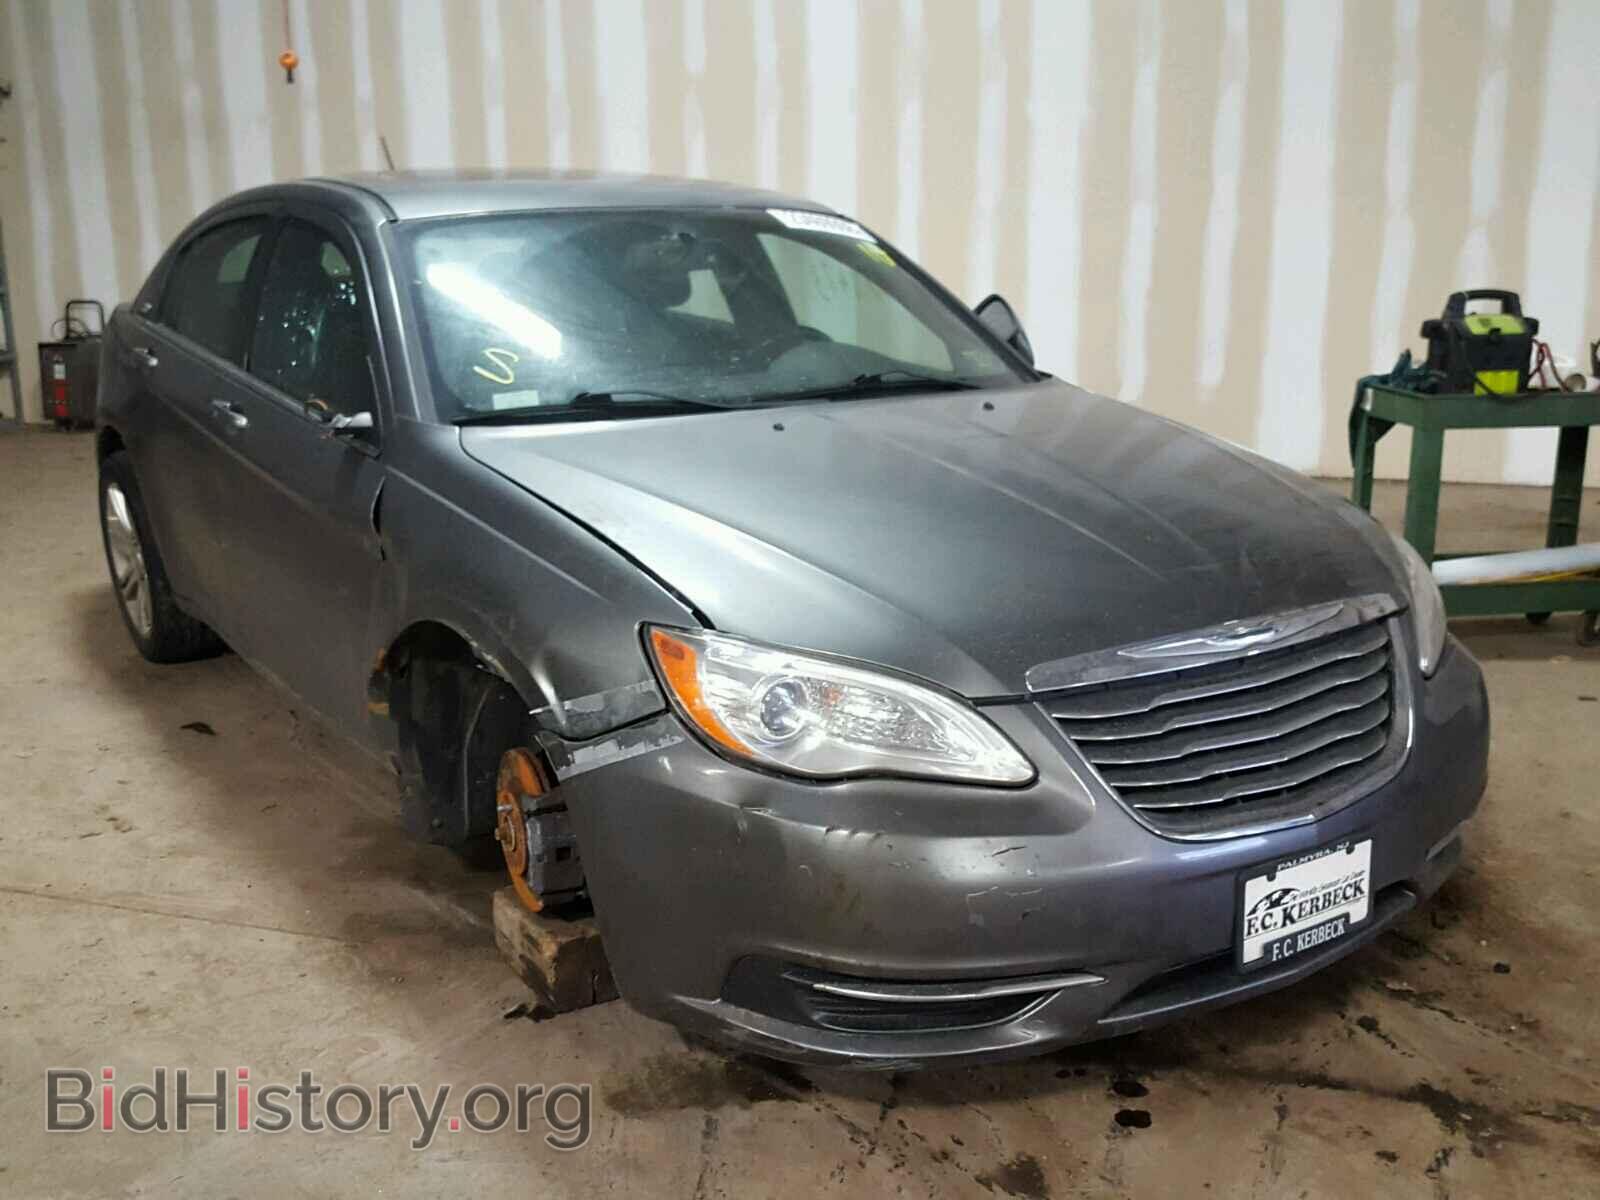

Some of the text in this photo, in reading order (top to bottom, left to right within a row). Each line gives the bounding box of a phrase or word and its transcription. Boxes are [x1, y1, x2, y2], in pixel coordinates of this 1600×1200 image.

[1247, 912, 1278, 936] F.C.
[1281, 879, 1365, 928] KERBECK
[1271, 919, 1345, 962] F.C. KERBECK
